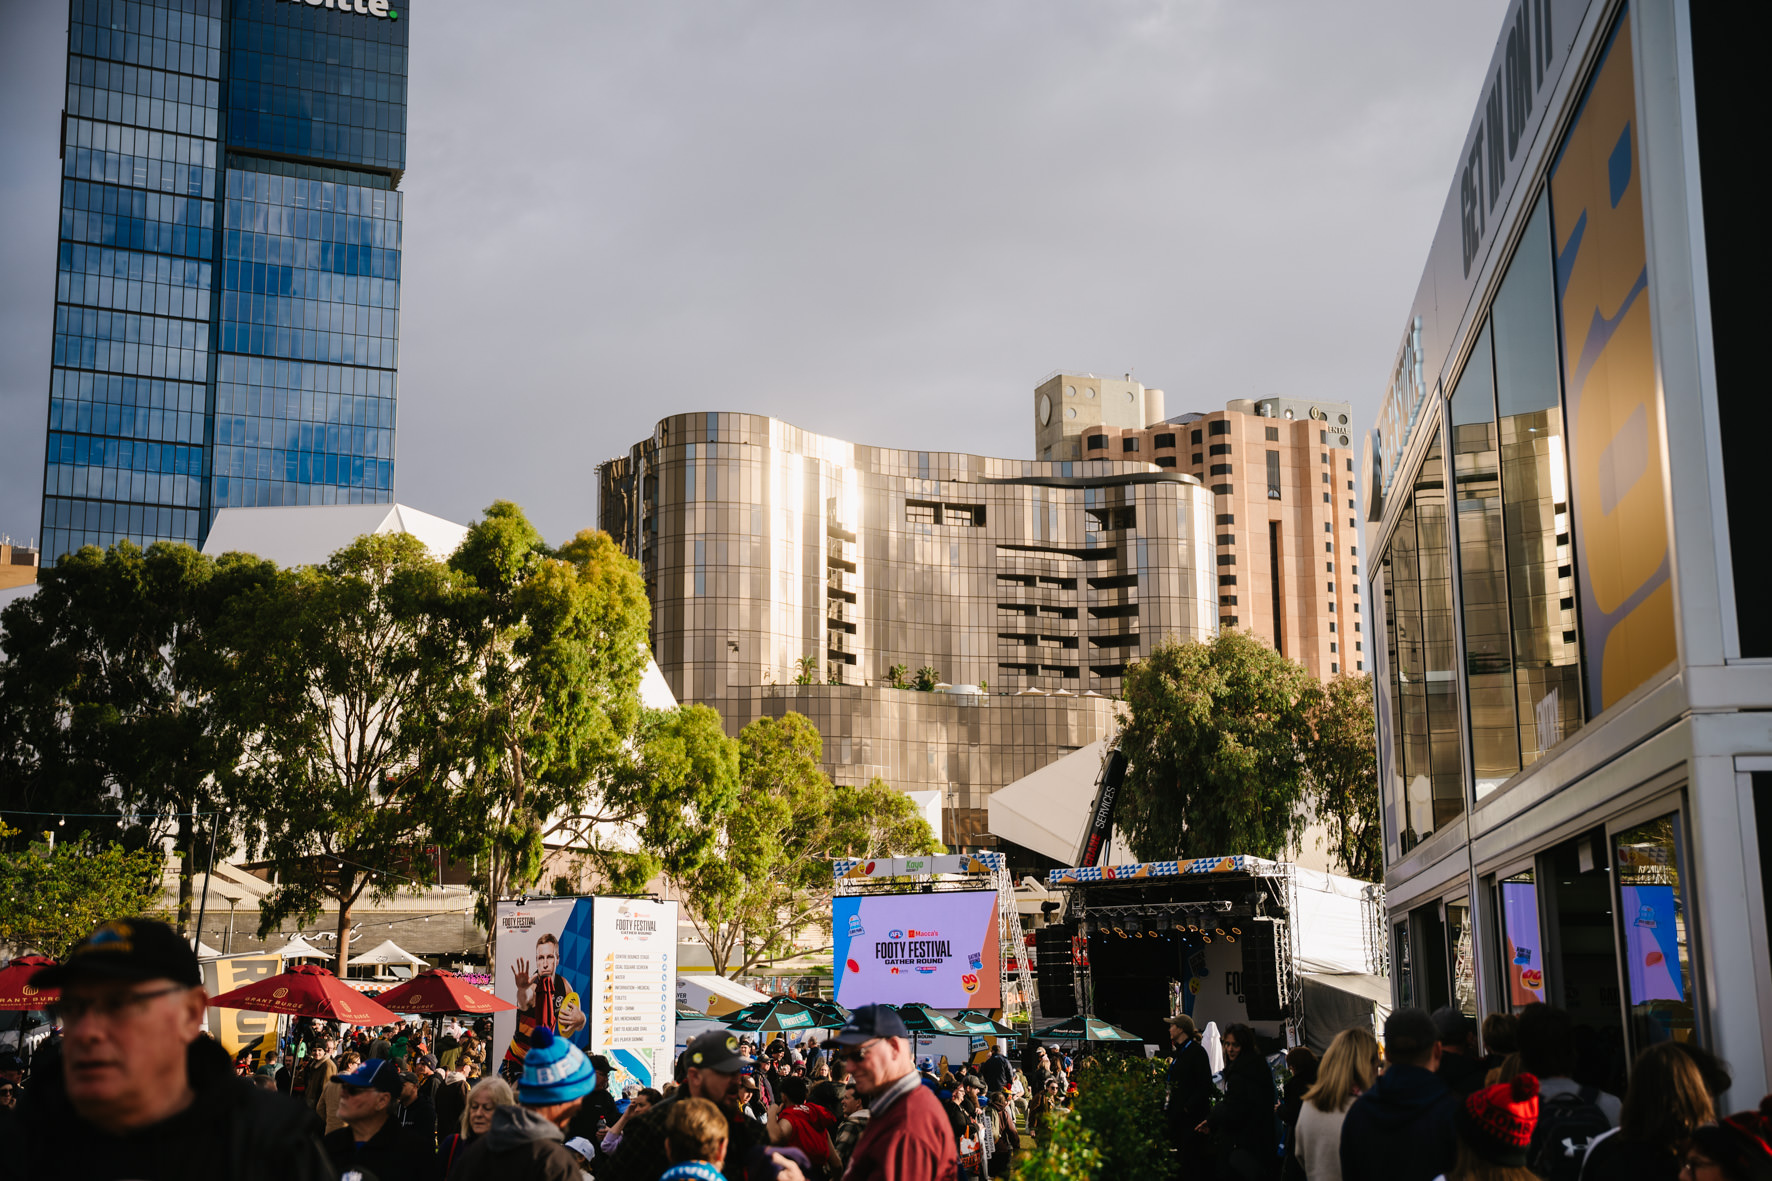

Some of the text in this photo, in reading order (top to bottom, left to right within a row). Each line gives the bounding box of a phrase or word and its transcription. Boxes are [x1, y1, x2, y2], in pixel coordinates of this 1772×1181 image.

[1461, 118, 1485, 280] GET
[1486, 64, 1505, 216] IN
[1505, 0, 1532, 162] ON
[1084, 785, 1116, 867] CRANE SERVICES
[906, 860, 923, 871] Kayo
[502, 916, 536, 926] FOOTY FESTIVAL
[616, 919, 656, 931] FOOTY FESTIVAL
[875, 940, 952, 959] FOOTY FESTIVAL
[245, 996, 273, 1004] GRANT
[275, 999, 304, 1009] BURGE
